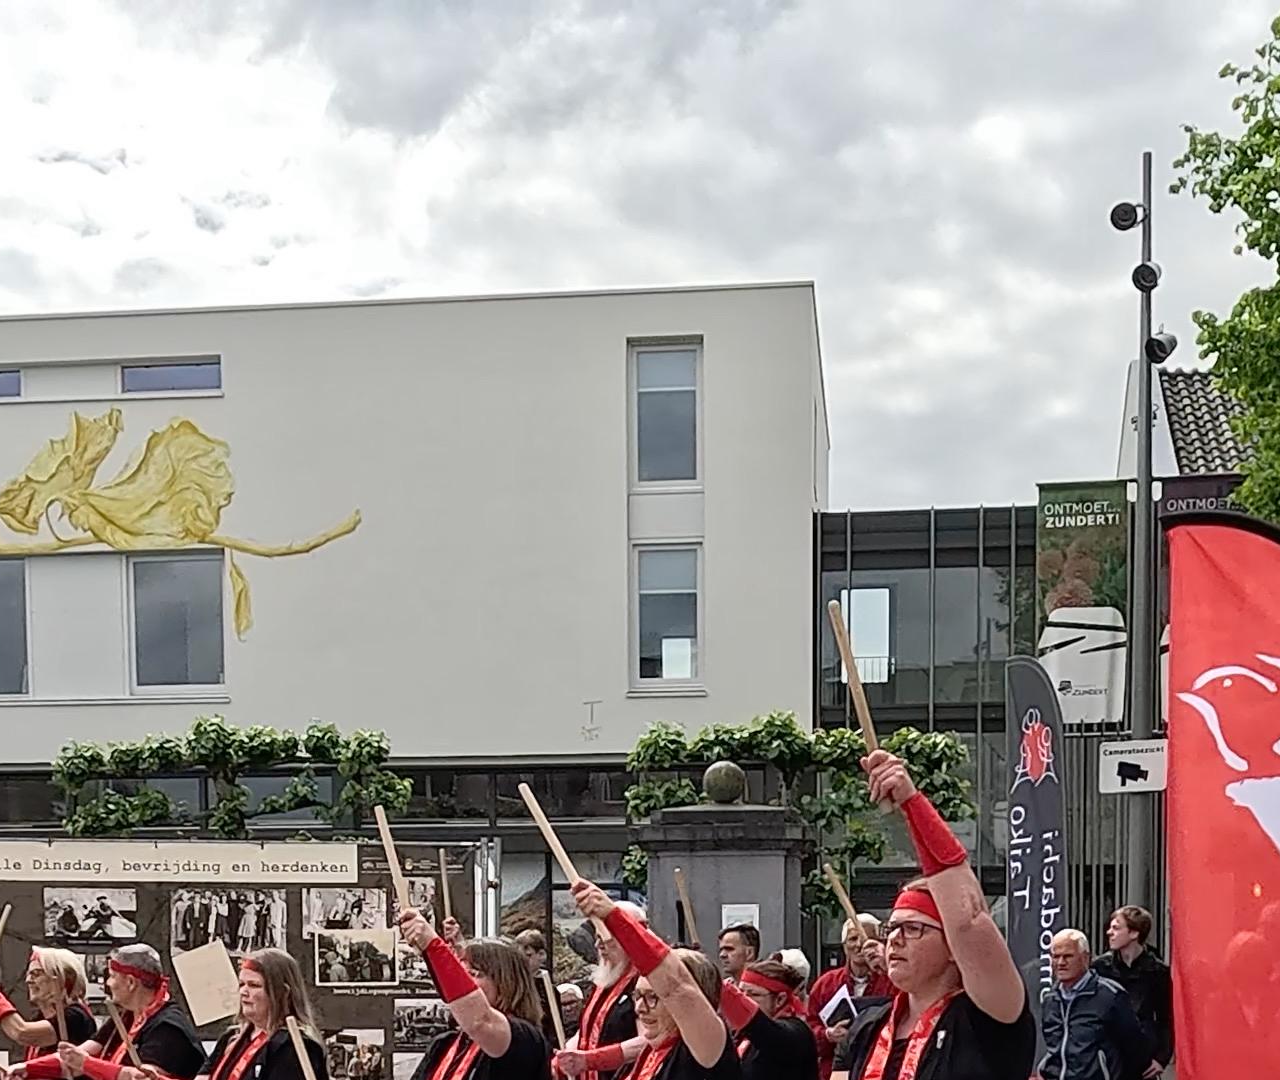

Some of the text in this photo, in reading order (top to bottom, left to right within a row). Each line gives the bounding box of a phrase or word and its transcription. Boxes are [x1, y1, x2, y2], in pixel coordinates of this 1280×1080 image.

[1045, 514, 1119, 528] ZUNDERT!
[32, 858, 111, 874] Dinsdag,
[122, 859, 221, 874] bevrijding
[231, 863, 251, 873] en
[261, 860, 349, 873] herdenken
